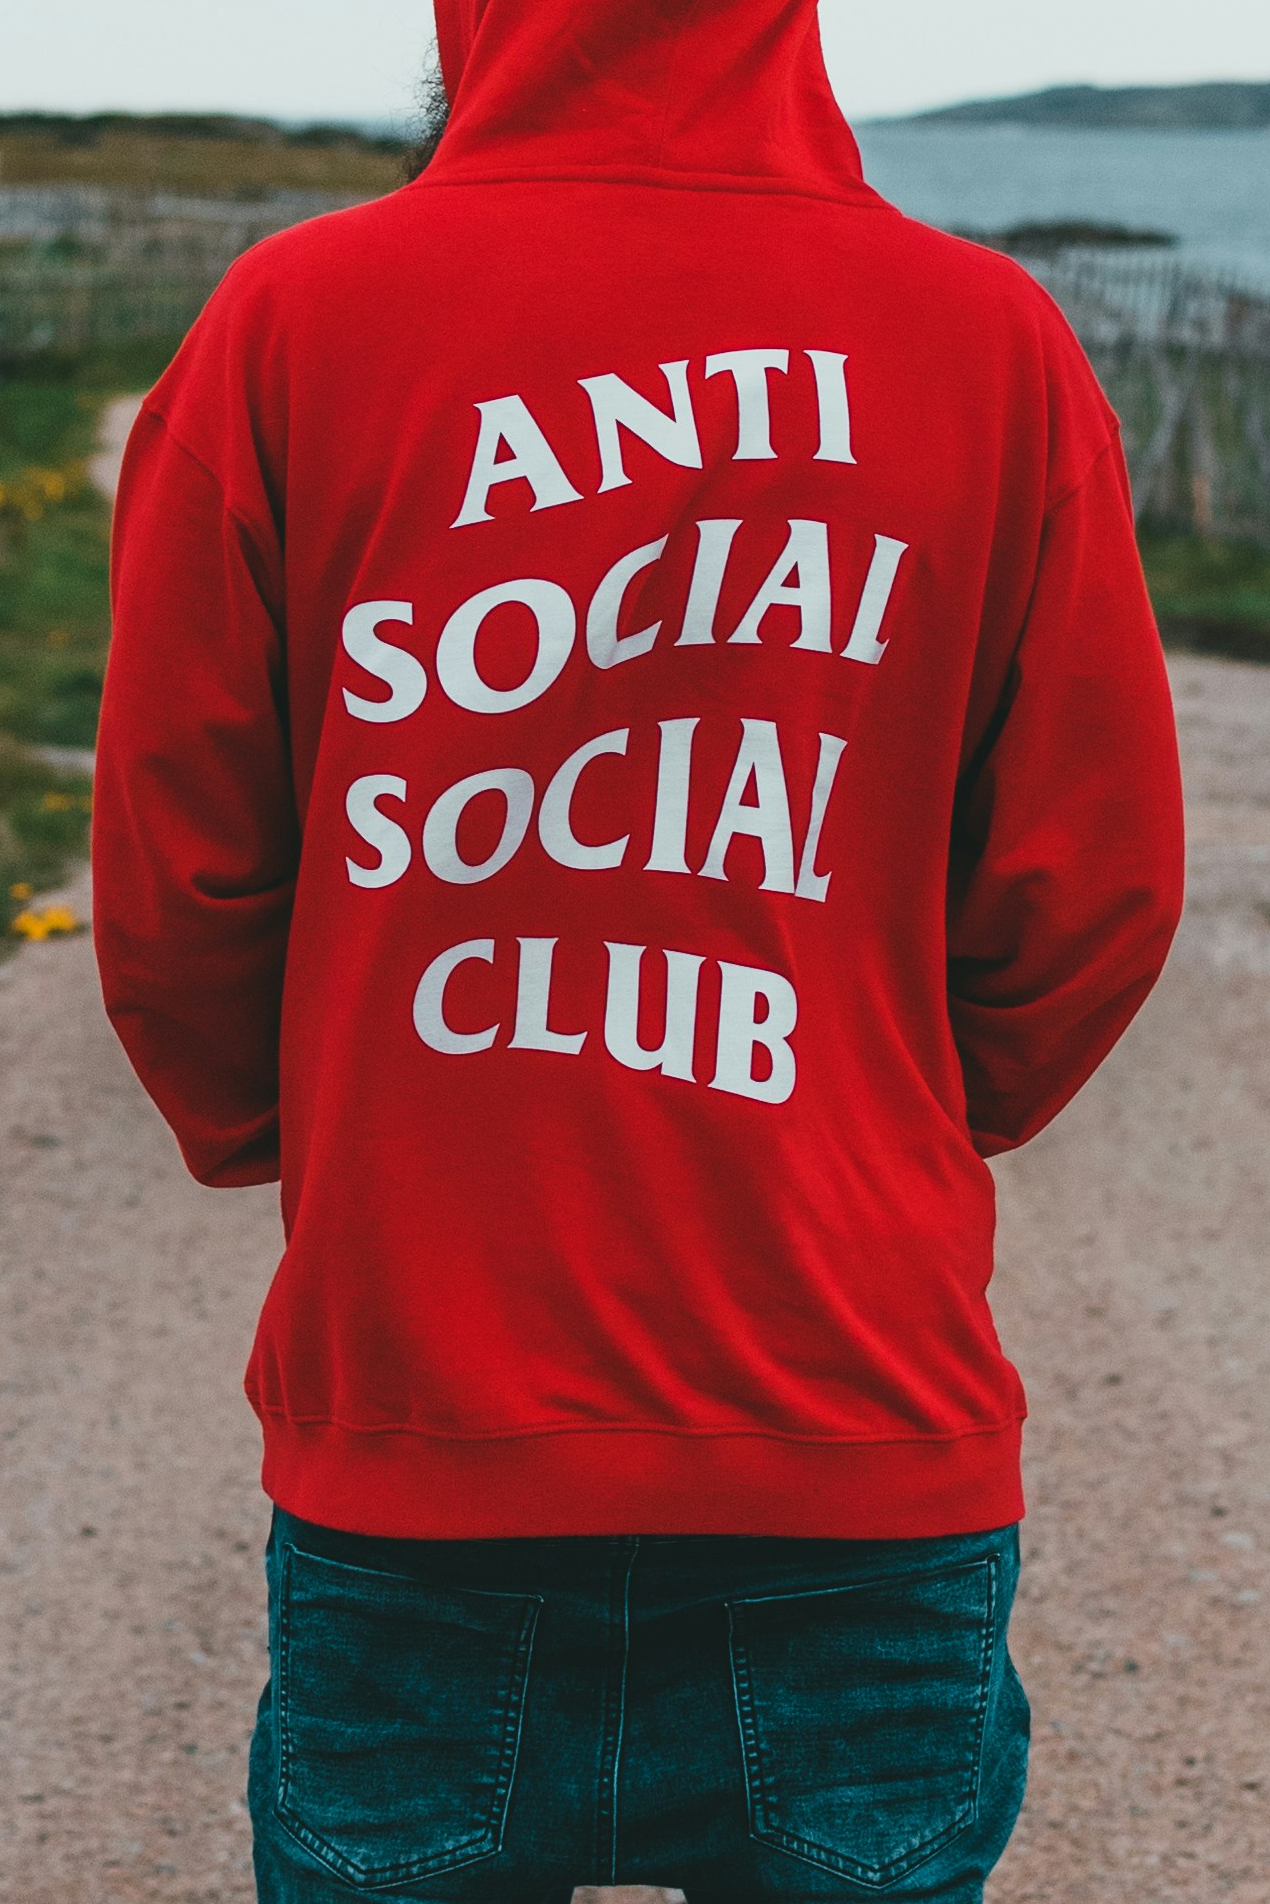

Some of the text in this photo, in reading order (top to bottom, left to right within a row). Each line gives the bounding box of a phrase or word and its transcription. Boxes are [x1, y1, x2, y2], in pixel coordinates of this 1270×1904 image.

[450, 349, 857, 529] ANTI
[342, 519, 909, 723] SOCIAL
[345, 718, 848, 903] SOCIAL
[413, 937, 797, 1104] CLUB
